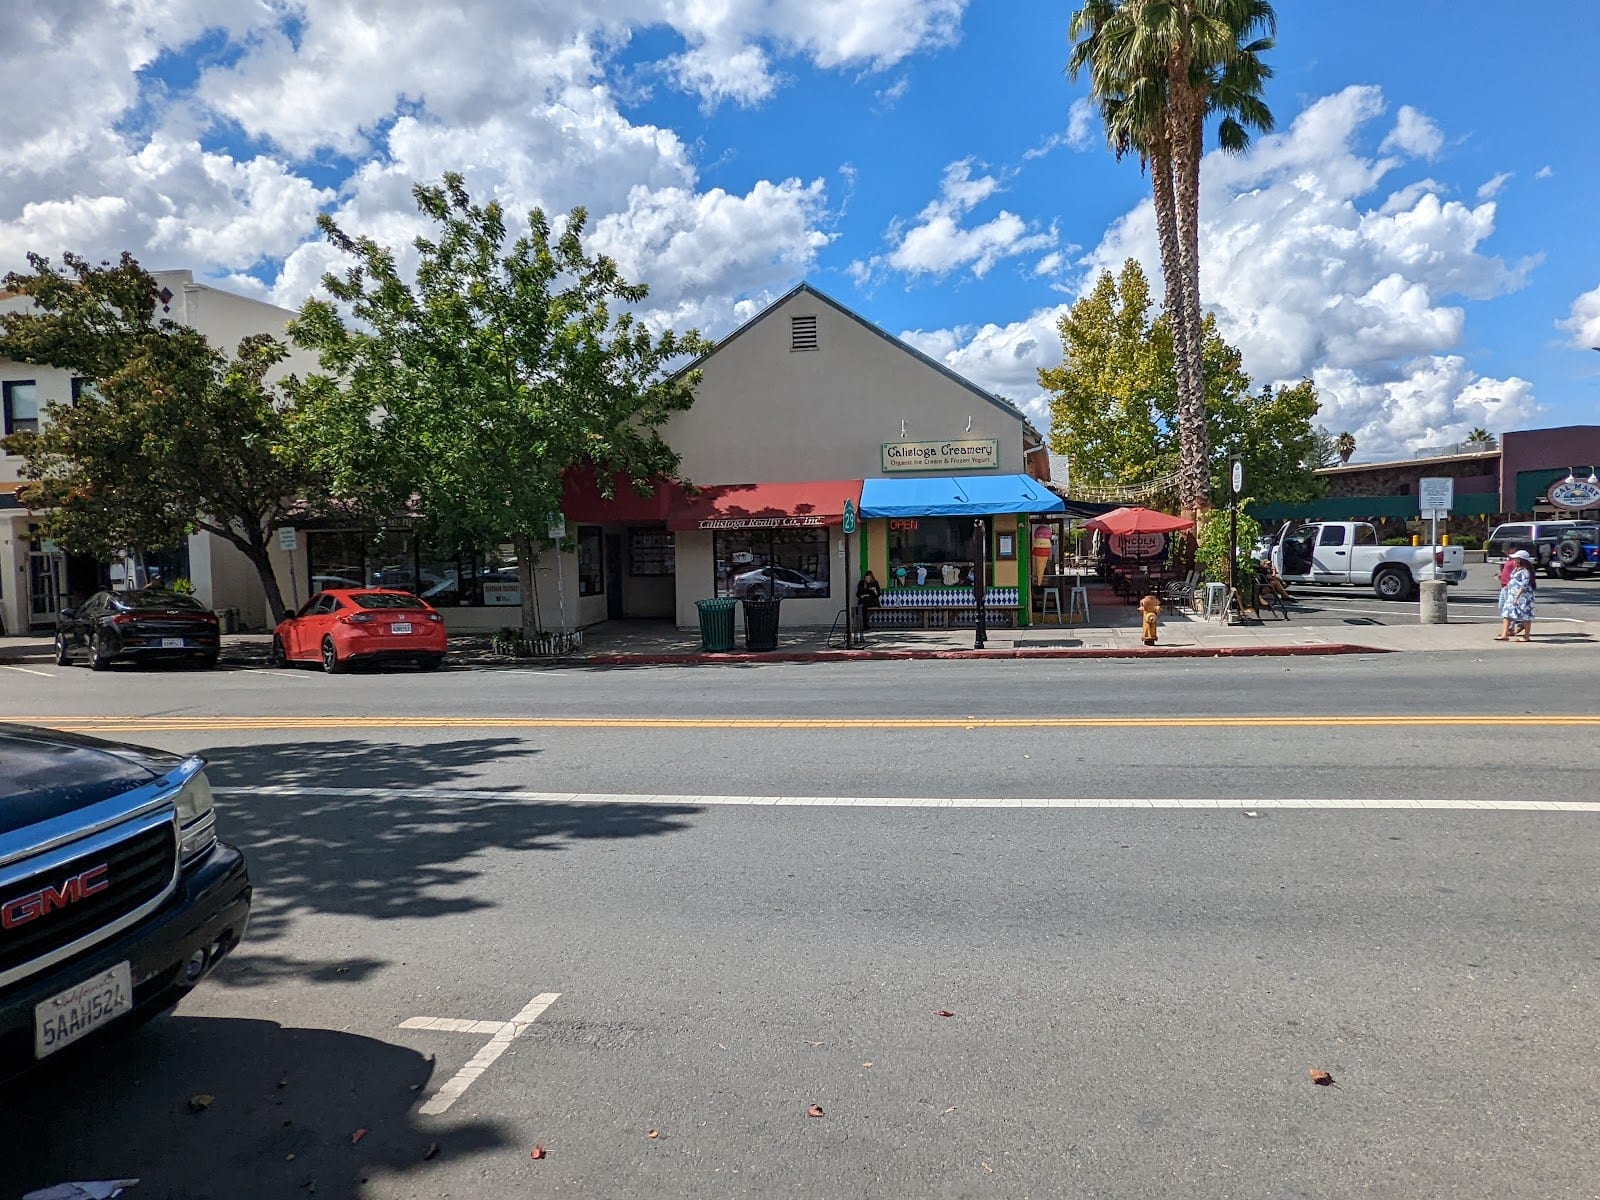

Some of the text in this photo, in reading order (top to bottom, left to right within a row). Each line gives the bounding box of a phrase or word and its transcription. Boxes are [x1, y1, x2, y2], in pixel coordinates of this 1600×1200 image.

[887, 443, 992, 459] Calistoga Creamery
[890, 459, 913, 467] Organic
[971, 456, 990, 464] Yogurt
[1554, 483, 1600, 498] CAL MART
[699, 519, 746, 530] Calistoga
[749, 517, 780, 529] Realty
[845, 513, 854, 529] 29
[890, 520, 918, 530] OPEN
[2, 863, 109, 929] GMC
[57, 974, 114, 1009] California
[43, 983, 125, 1046] 5AAH524
